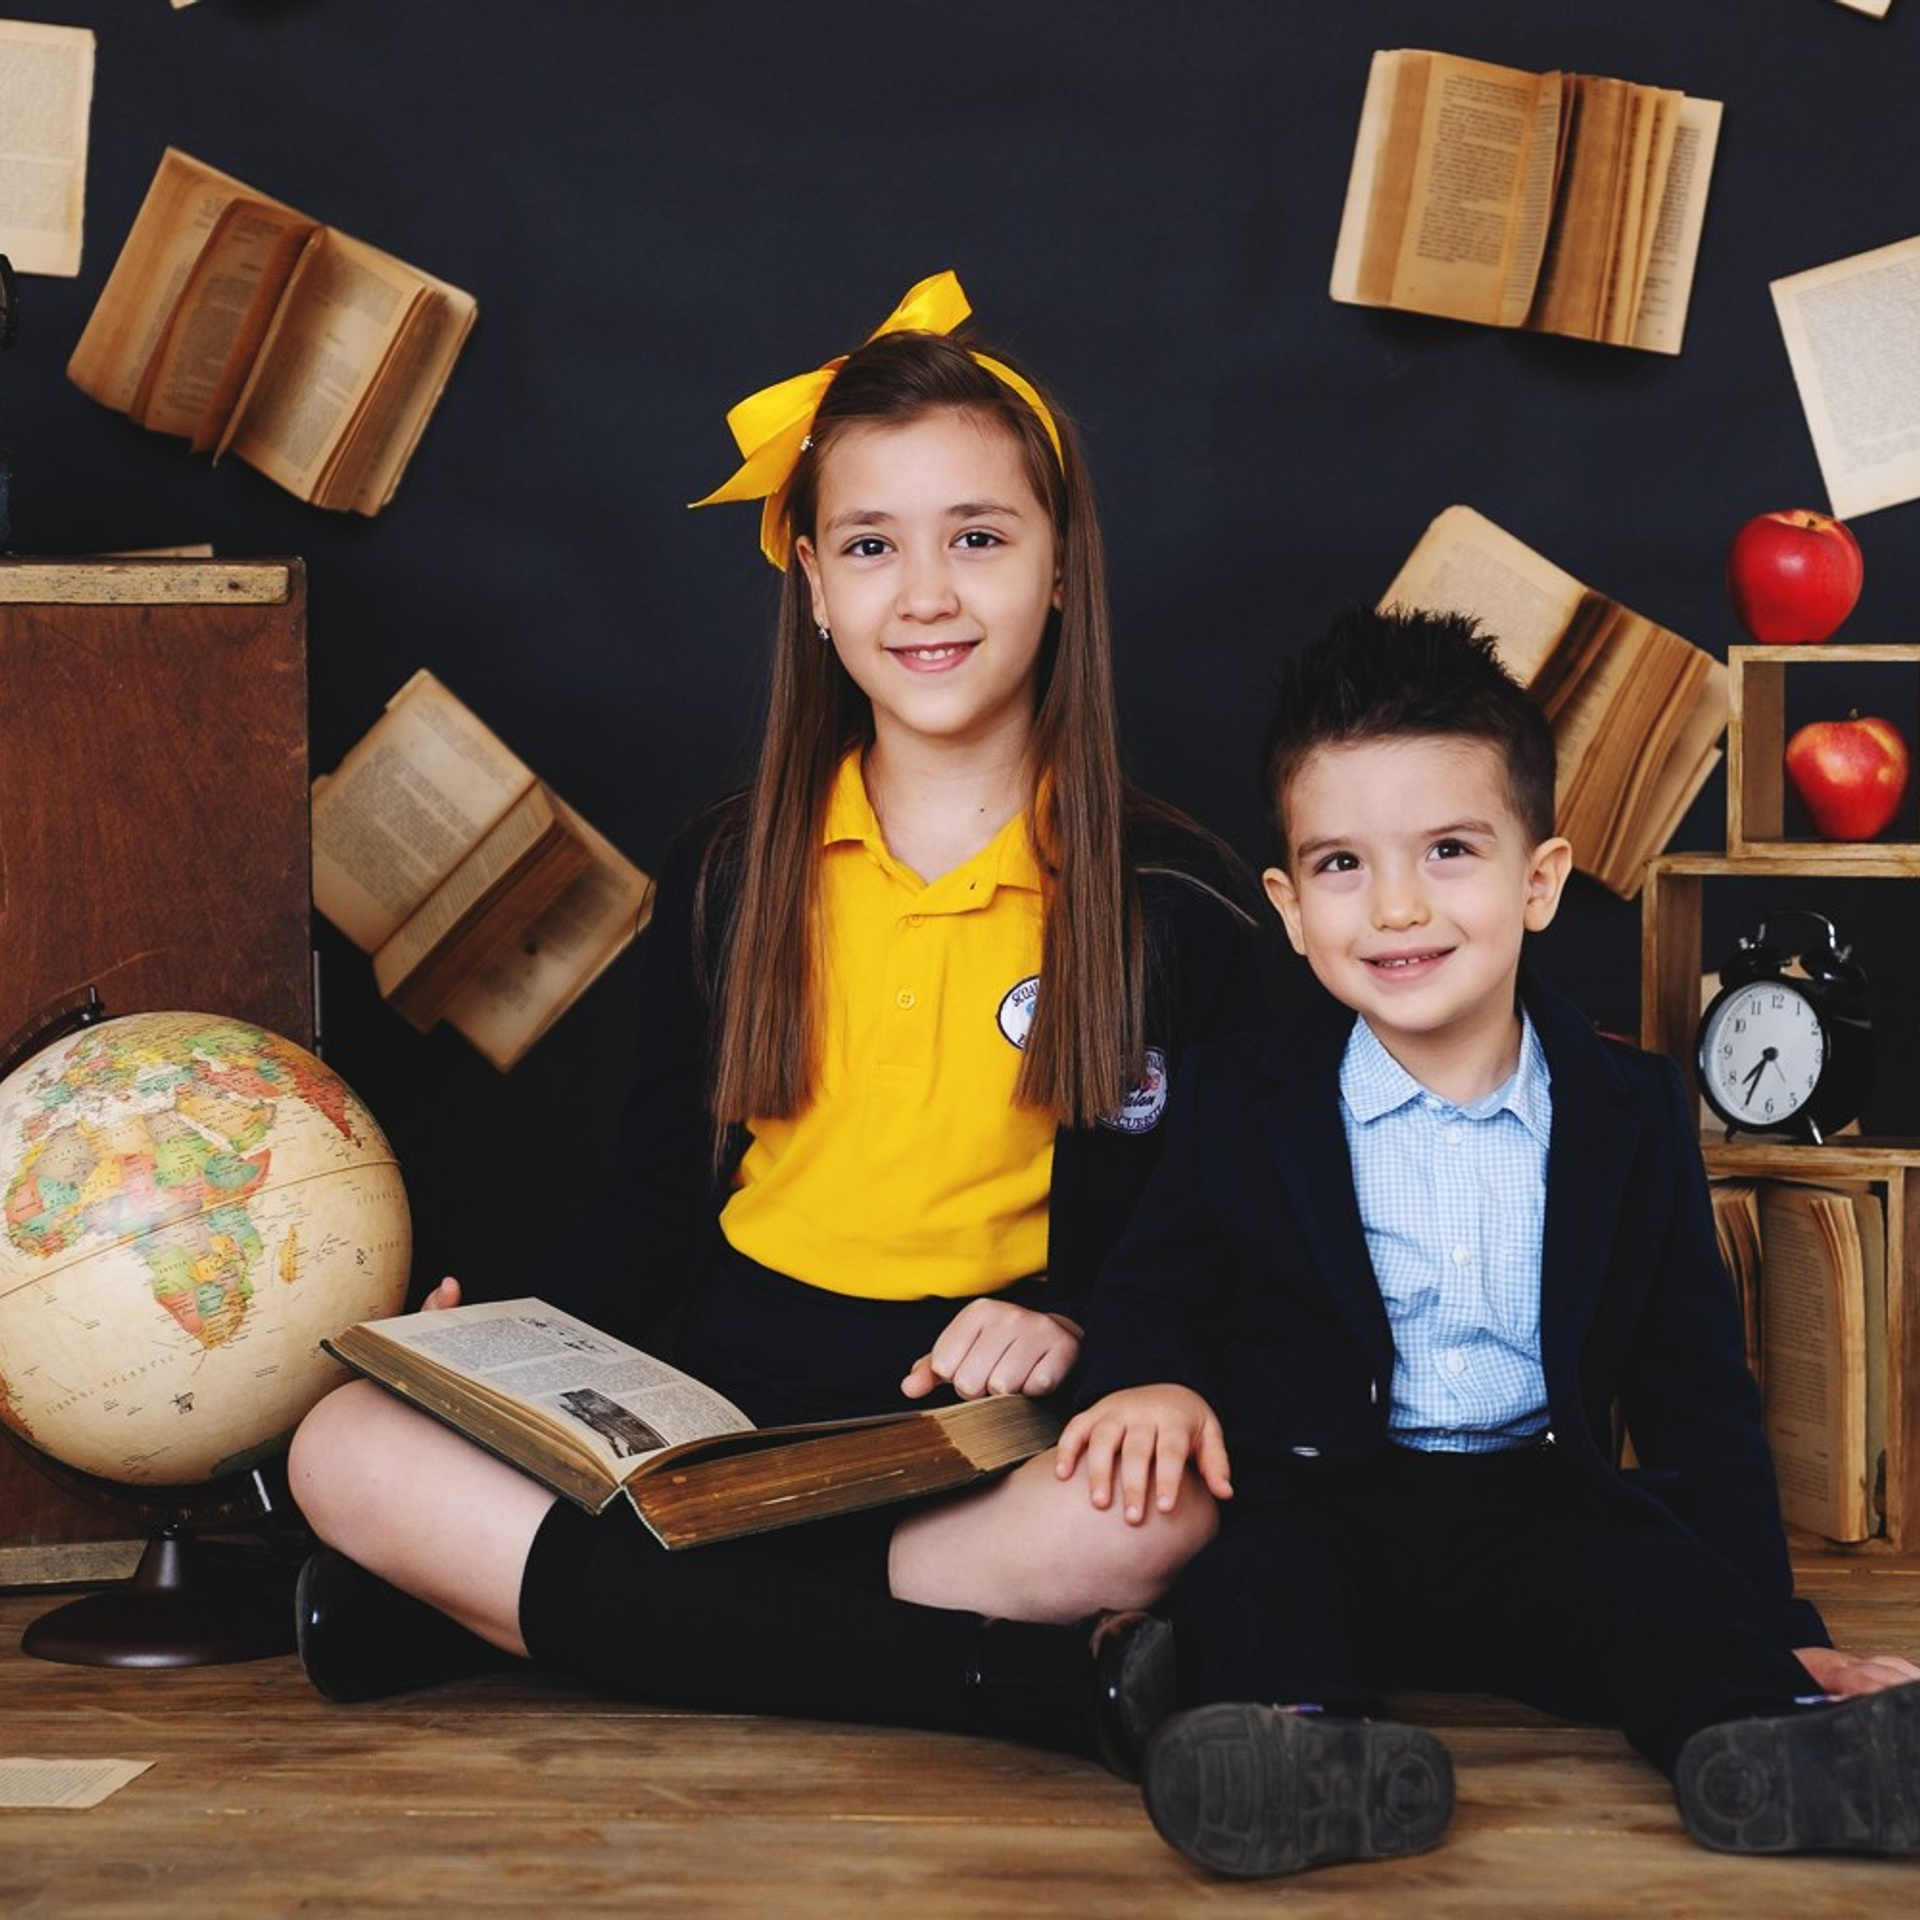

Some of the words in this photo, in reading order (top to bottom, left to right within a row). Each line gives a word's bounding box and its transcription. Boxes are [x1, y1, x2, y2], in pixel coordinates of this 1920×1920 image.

[1751, 1000, 1761, 1015] 11
[1772, 994, 1785, 1009] 12
[1796, 1000, 1801, 1015] 1
[1735, 1018, 1746, 1033] 10
[1811, 1020, 1820, 1036] 2
[1724, 1044, 1733, 1059] 9
[1728, 1070, 1736, 1085] 8
[1806, 1074, 1814, 1088] 4
[1765, 1098, 1774, 1113] 6
[1789, 1092, 1797, 1107] 5
